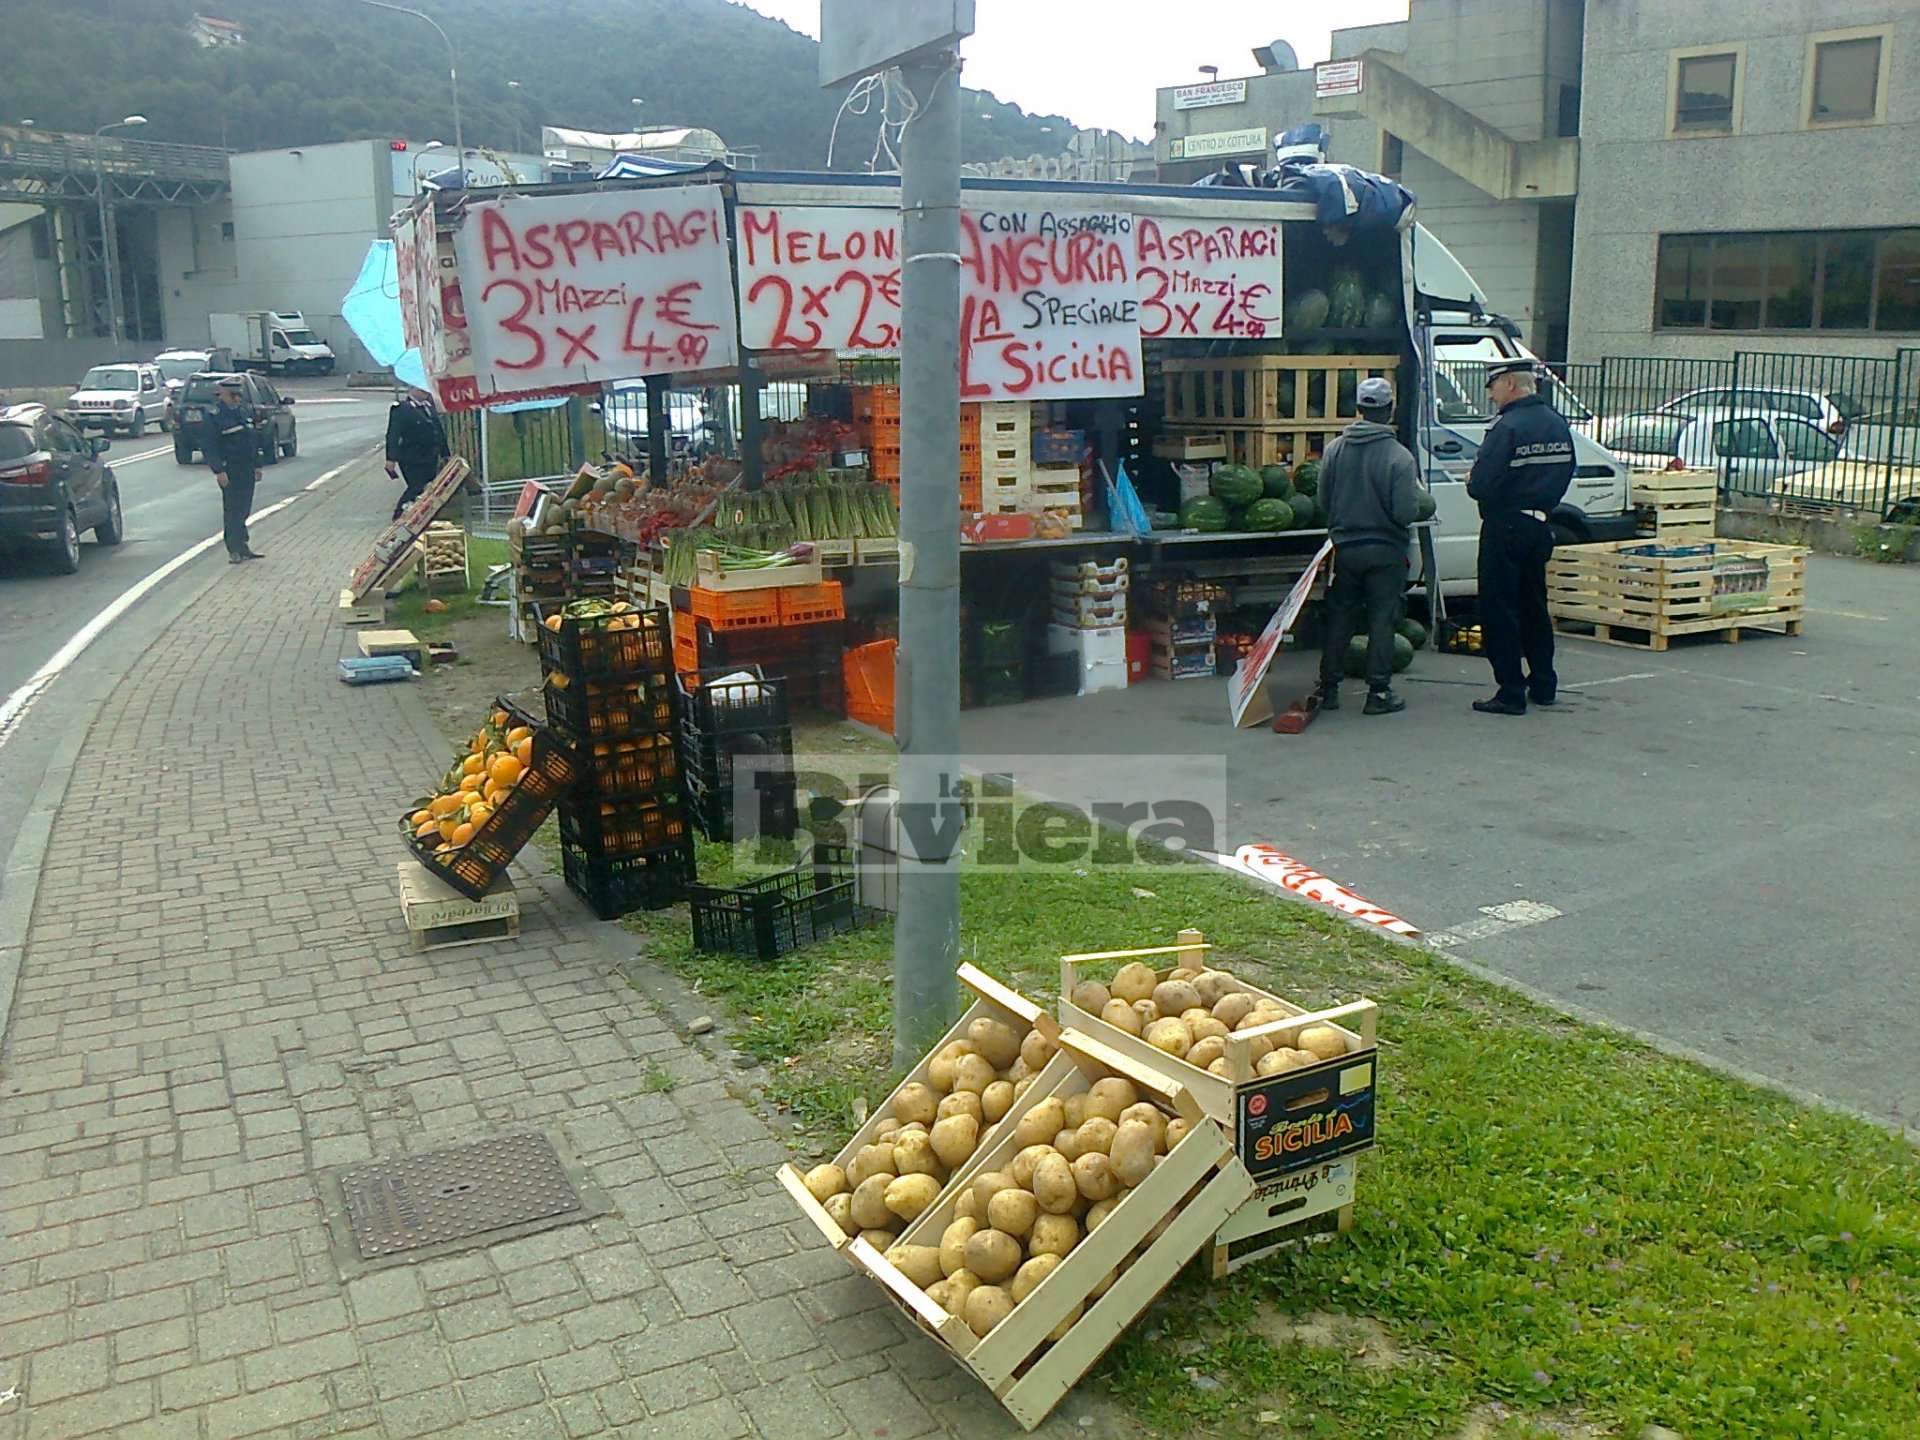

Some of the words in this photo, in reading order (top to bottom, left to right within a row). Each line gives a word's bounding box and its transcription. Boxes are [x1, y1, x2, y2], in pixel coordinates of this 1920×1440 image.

[1227, 134, 1262, 148] COTTURA
[481, 208, 720, 271] ASPARAGI
[482, 278, 546, 369] 3
[749, 275, 822, 350] 2
[1136, 266, 1172, 336] 3
[1515, 444, 1545, 456] POLIZIA
[1254, 1112, 1353, 1161] SICILIA
